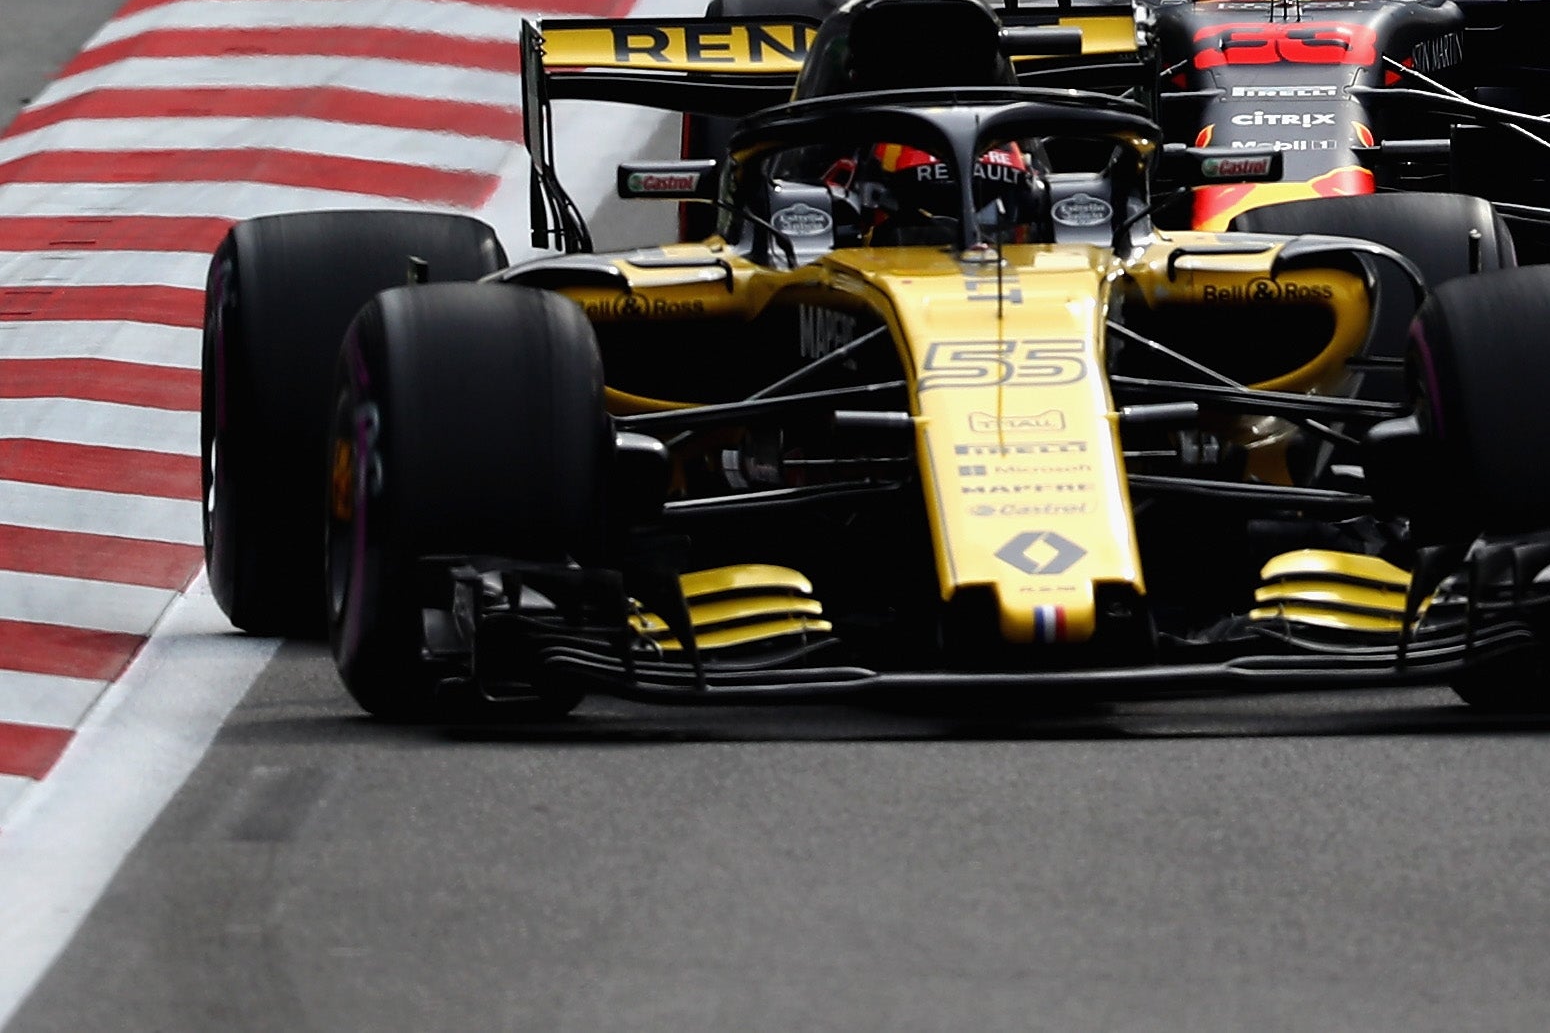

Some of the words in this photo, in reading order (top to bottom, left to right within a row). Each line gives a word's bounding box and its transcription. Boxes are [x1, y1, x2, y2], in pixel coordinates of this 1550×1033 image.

[1232, 86, 1337, 97] PIRELLI
[1231, 140, 1307, 151] Mobil
[917, 163, 1021, 185] REAULT
[1220, 159, 1267, 174] Castrol
[643, 175, 694, 190] Castrol
[1203, 285, 1243, 303] Bell
[1285, 282, 1333, 300] Ross
[917, 338, 1088, 392] 55
